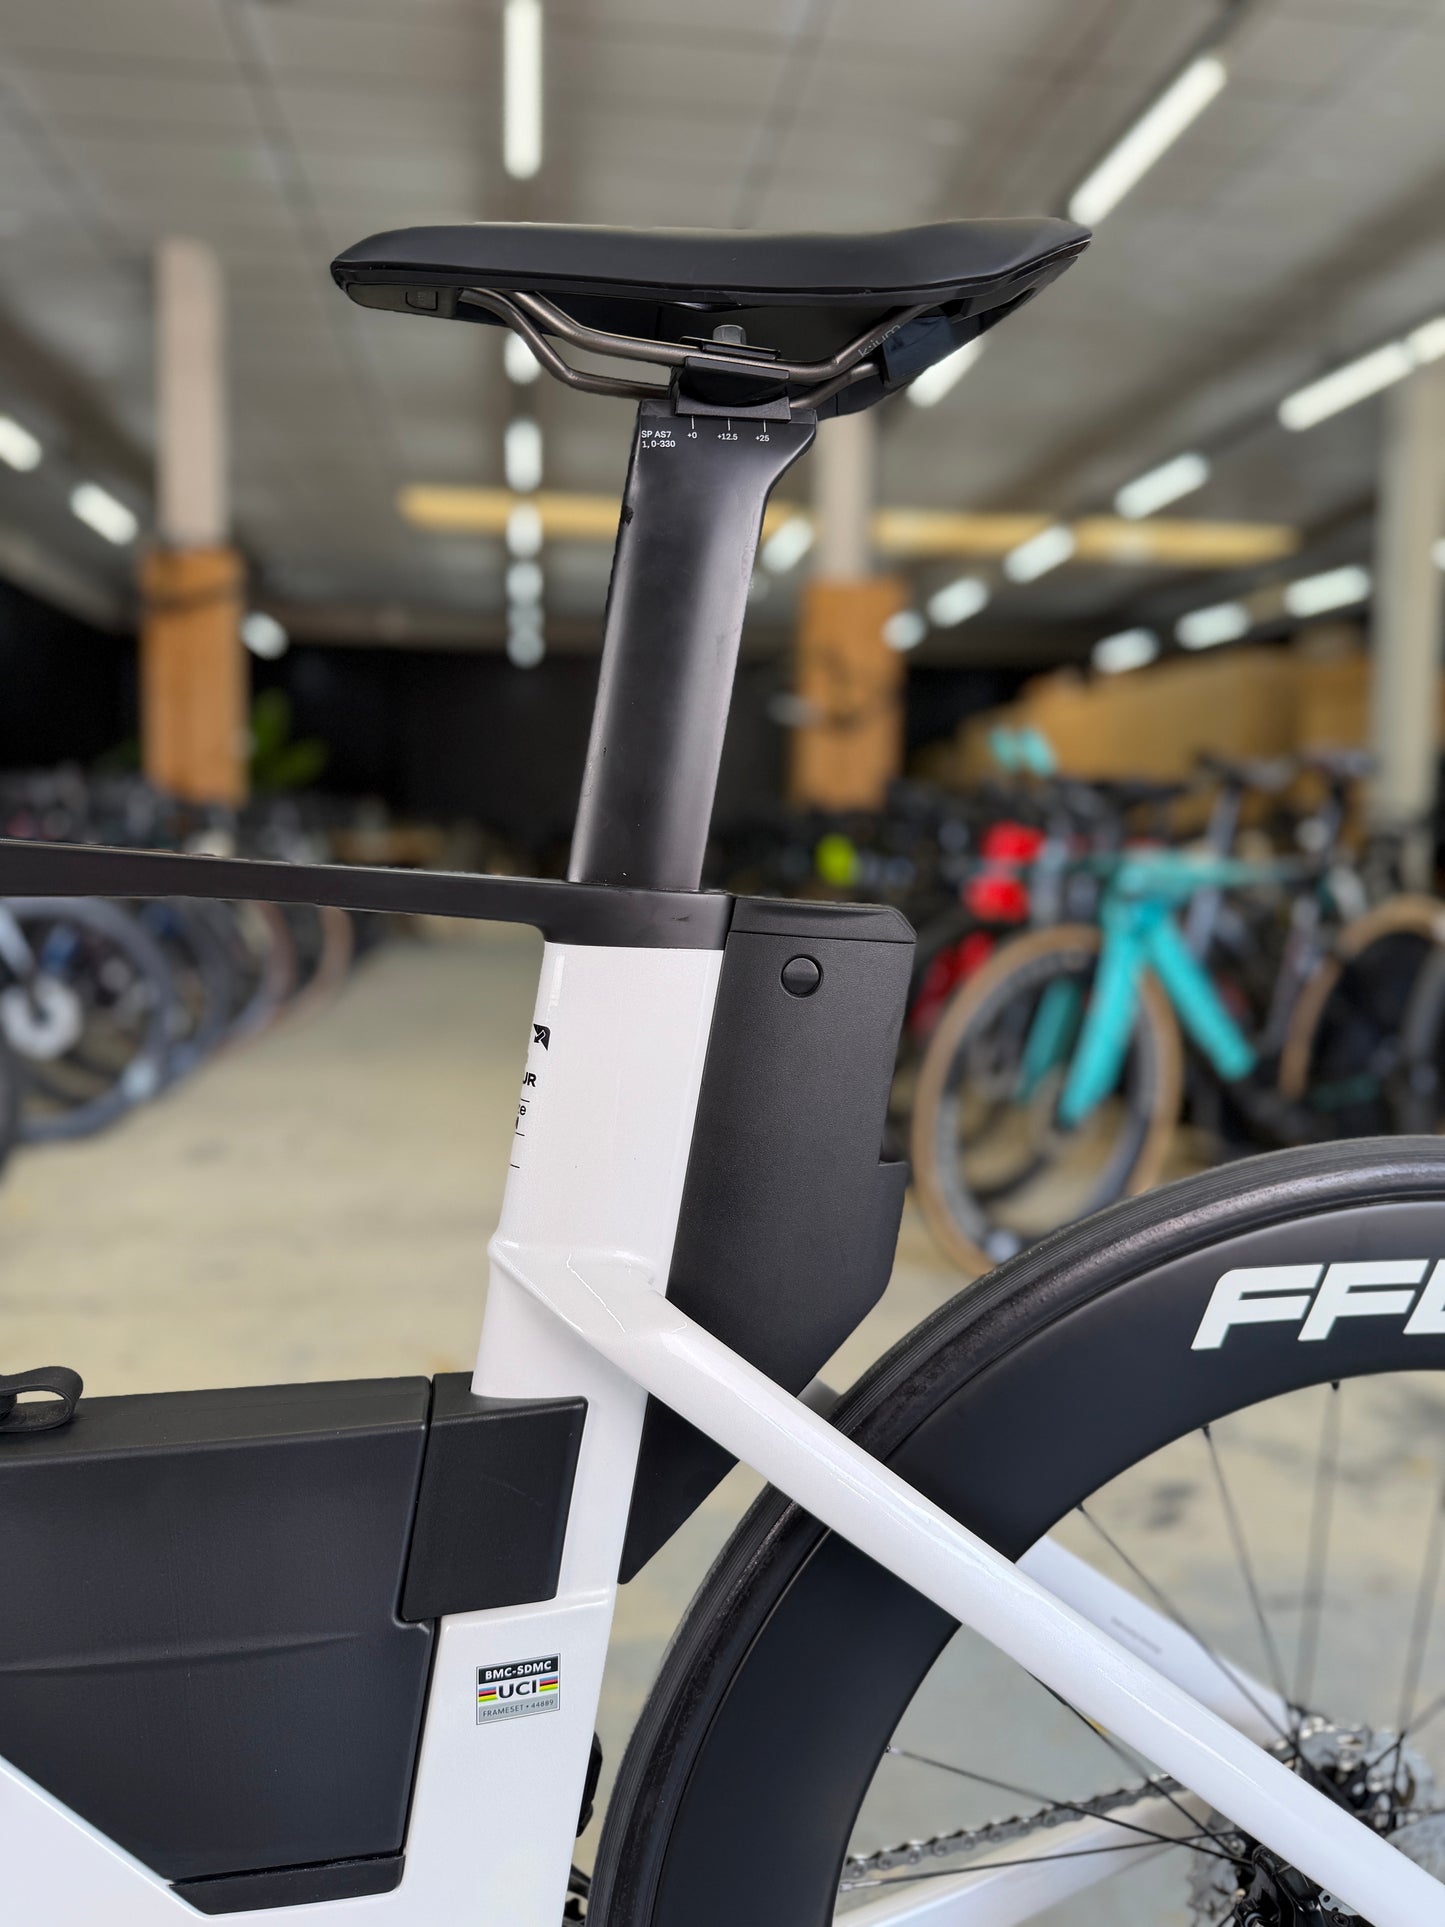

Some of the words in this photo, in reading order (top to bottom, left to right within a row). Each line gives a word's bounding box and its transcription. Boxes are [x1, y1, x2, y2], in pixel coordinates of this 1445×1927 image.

[641, 430, 653, 439] SP
[654, 431, 672, 439] AS7
[717, 433, 738, 441] +12.5
[755, 434, 770, 442] +25
[651, 440, 676, 448] 0-330
[485, 1660, 552, 1680] BMC-SDMC
[498, 1679, 537, 1699] UCI
[483, 1704, 524, 1717] FRAMESET
